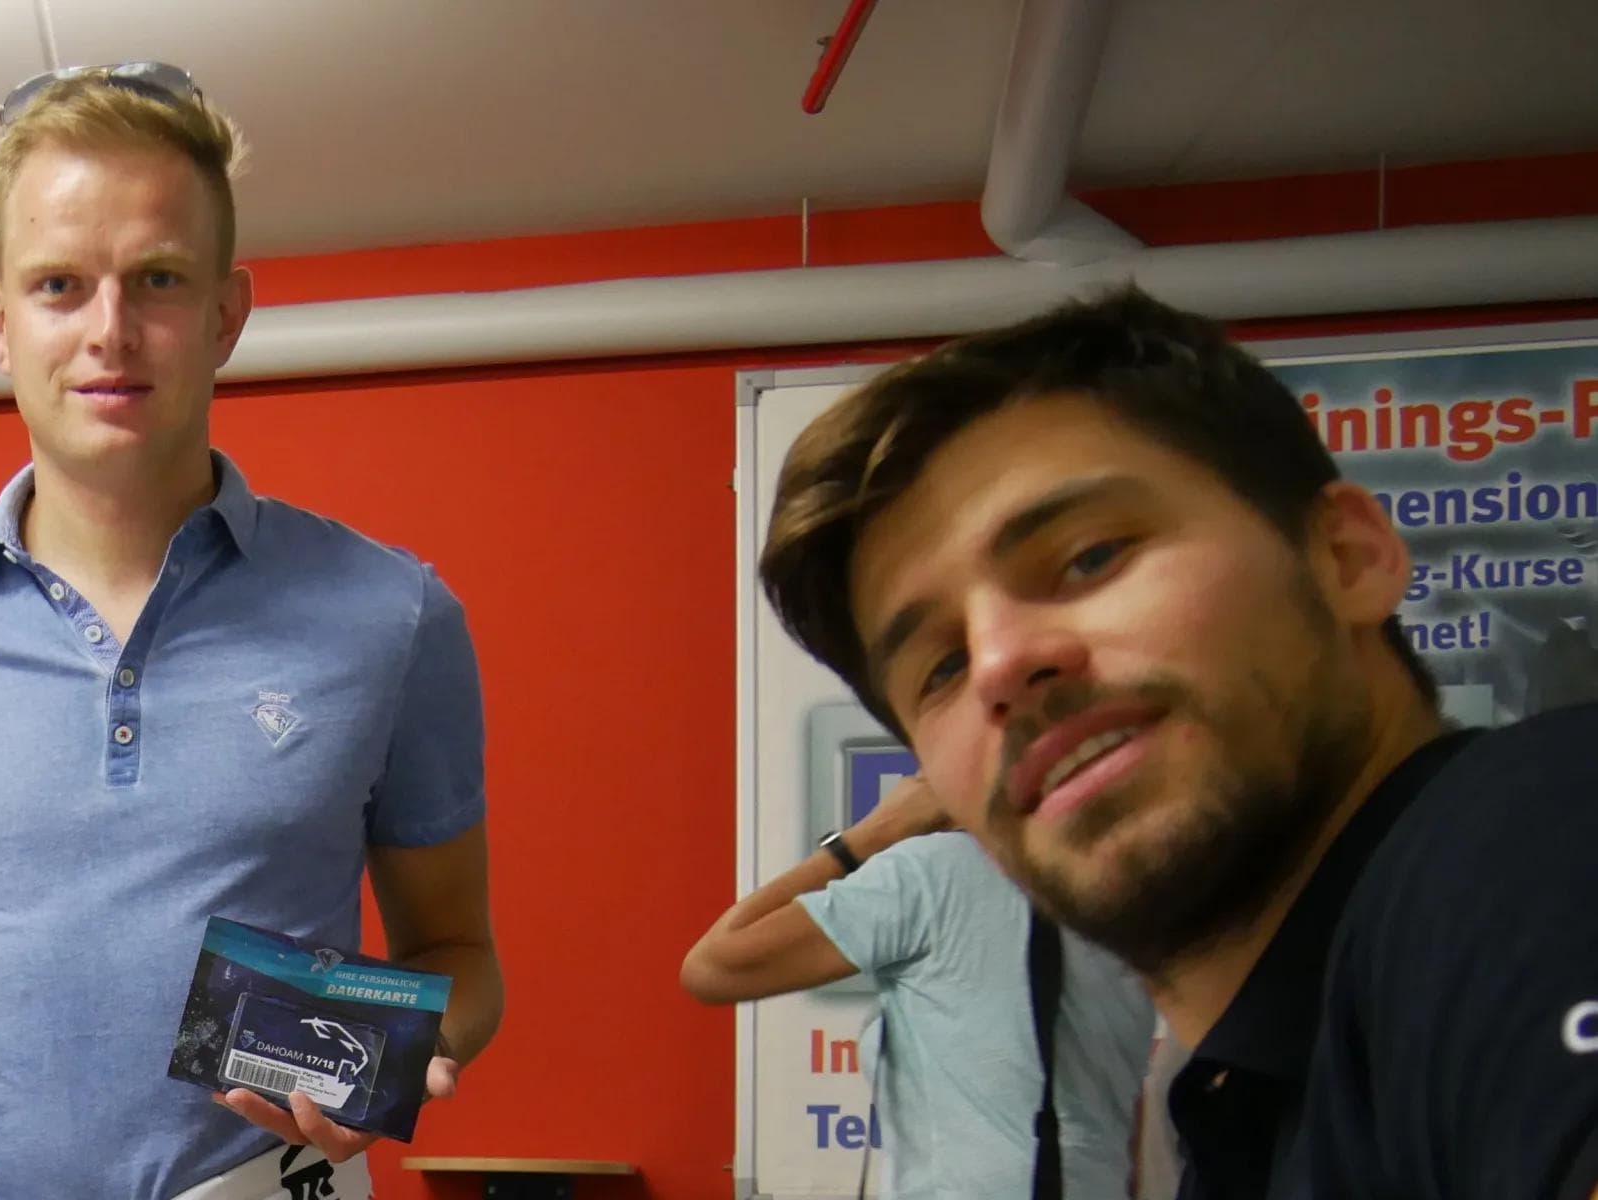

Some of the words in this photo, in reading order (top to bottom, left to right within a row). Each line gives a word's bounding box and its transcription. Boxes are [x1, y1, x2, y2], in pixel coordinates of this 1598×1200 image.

[358, 974, 424, 989] PERSÖNLICHE
[325, 983, 418, 1005] DAUERKARTE
[256, 1041, 304, 1063] DAHOAM
[305, 1054, 335, 1070] 17/18
